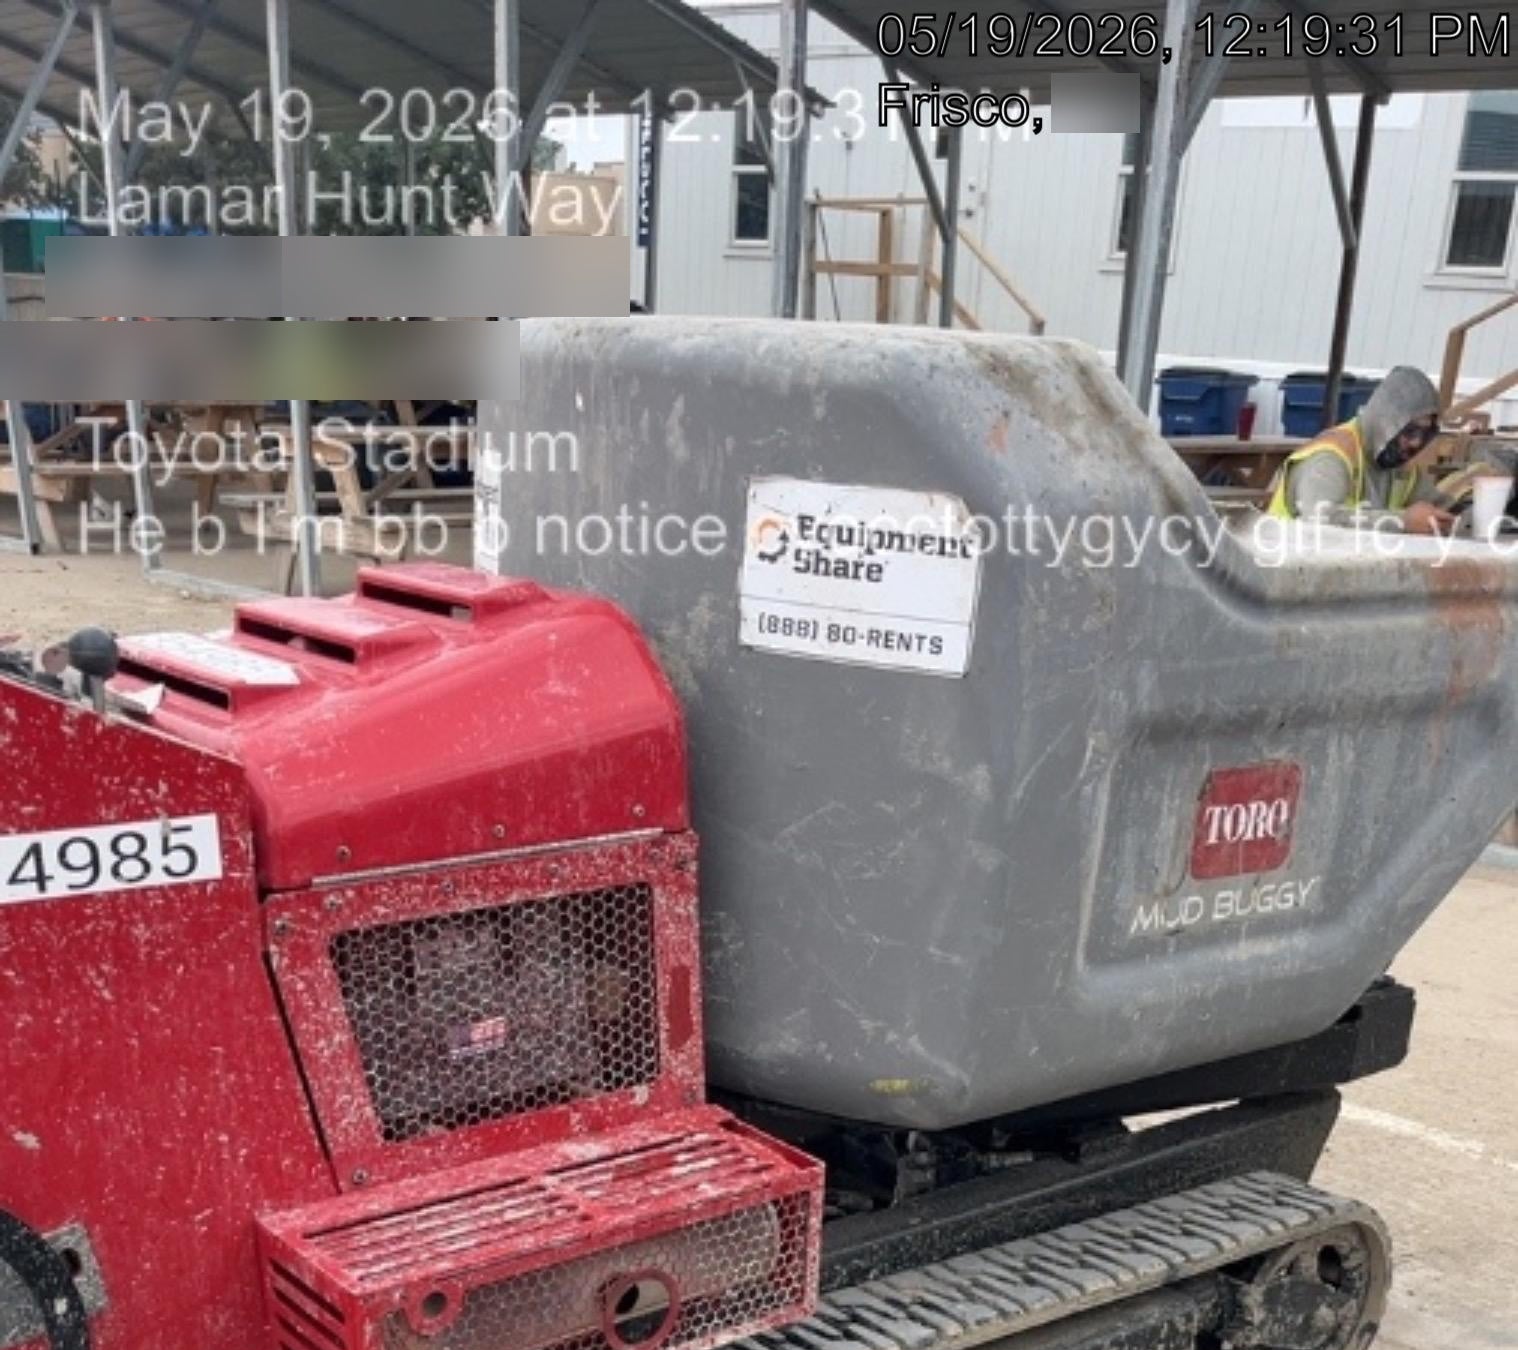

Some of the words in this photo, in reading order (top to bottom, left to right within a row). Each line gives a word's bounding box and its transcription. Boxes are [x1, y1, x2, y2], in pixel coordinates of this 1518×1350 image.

[797, 514, 973, 560] Equipment
[793, 548, 884, 583] Share
[758, 611, 819, 640] (888)
[826, 622, 943, 655] 80-RENTS
[1204, 797, 1289, 845] TORO
[6, 824, 199, 894] 4985
[1129, 894, 1205, 936] MUD
[1211, 874, 1322, 921] BUGGY
